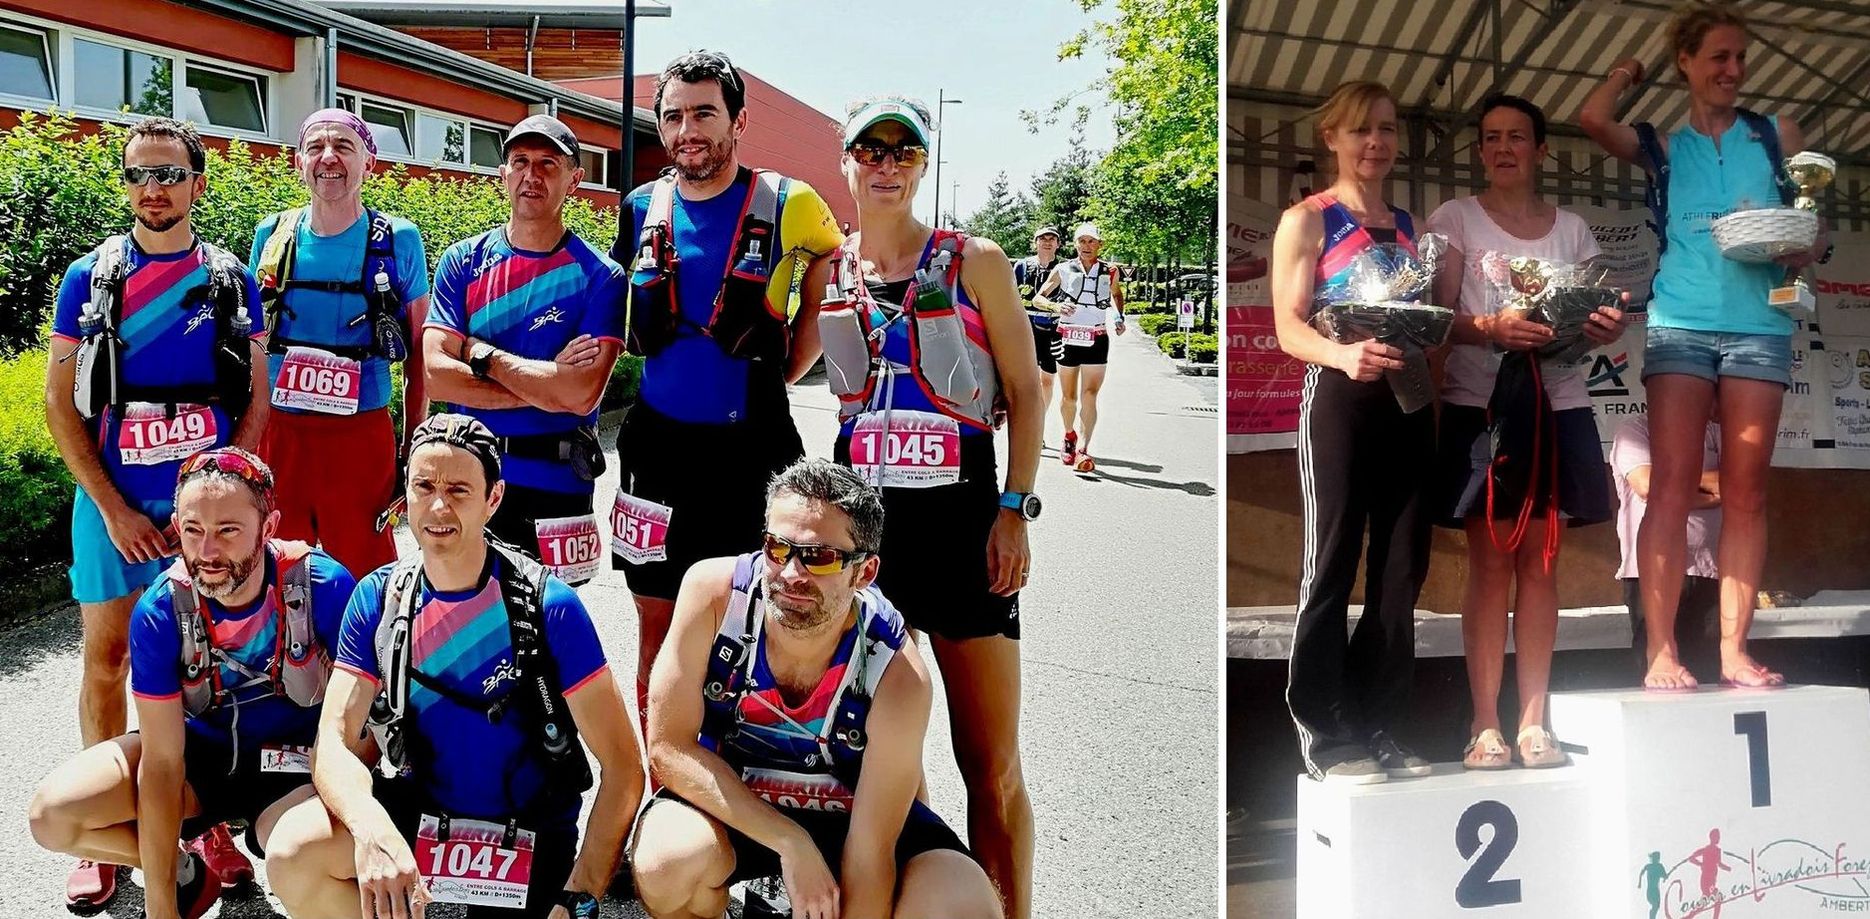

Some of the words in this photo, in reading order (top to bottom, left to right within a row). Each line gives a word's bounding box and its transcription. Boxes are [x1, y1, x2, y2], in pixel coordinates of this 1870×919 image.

[1067, 330, 1091, 340] 1039
[287, 364, 351, 397] 1069
[1255, 388, 1300, 399] formules
[129, 413, 205, 448] 1049
[862, 433, 945, 466] 1045
[548, 533, 598, 565] 1052
[537, 676, 554, 715] HYDRAGON
[1734, 711, 1772, 808] 1
[430, 843, 518, 880] 1047
[1455, 800, 1522, 908] 2
[1820, 898, 1870, 912] AMBERT
